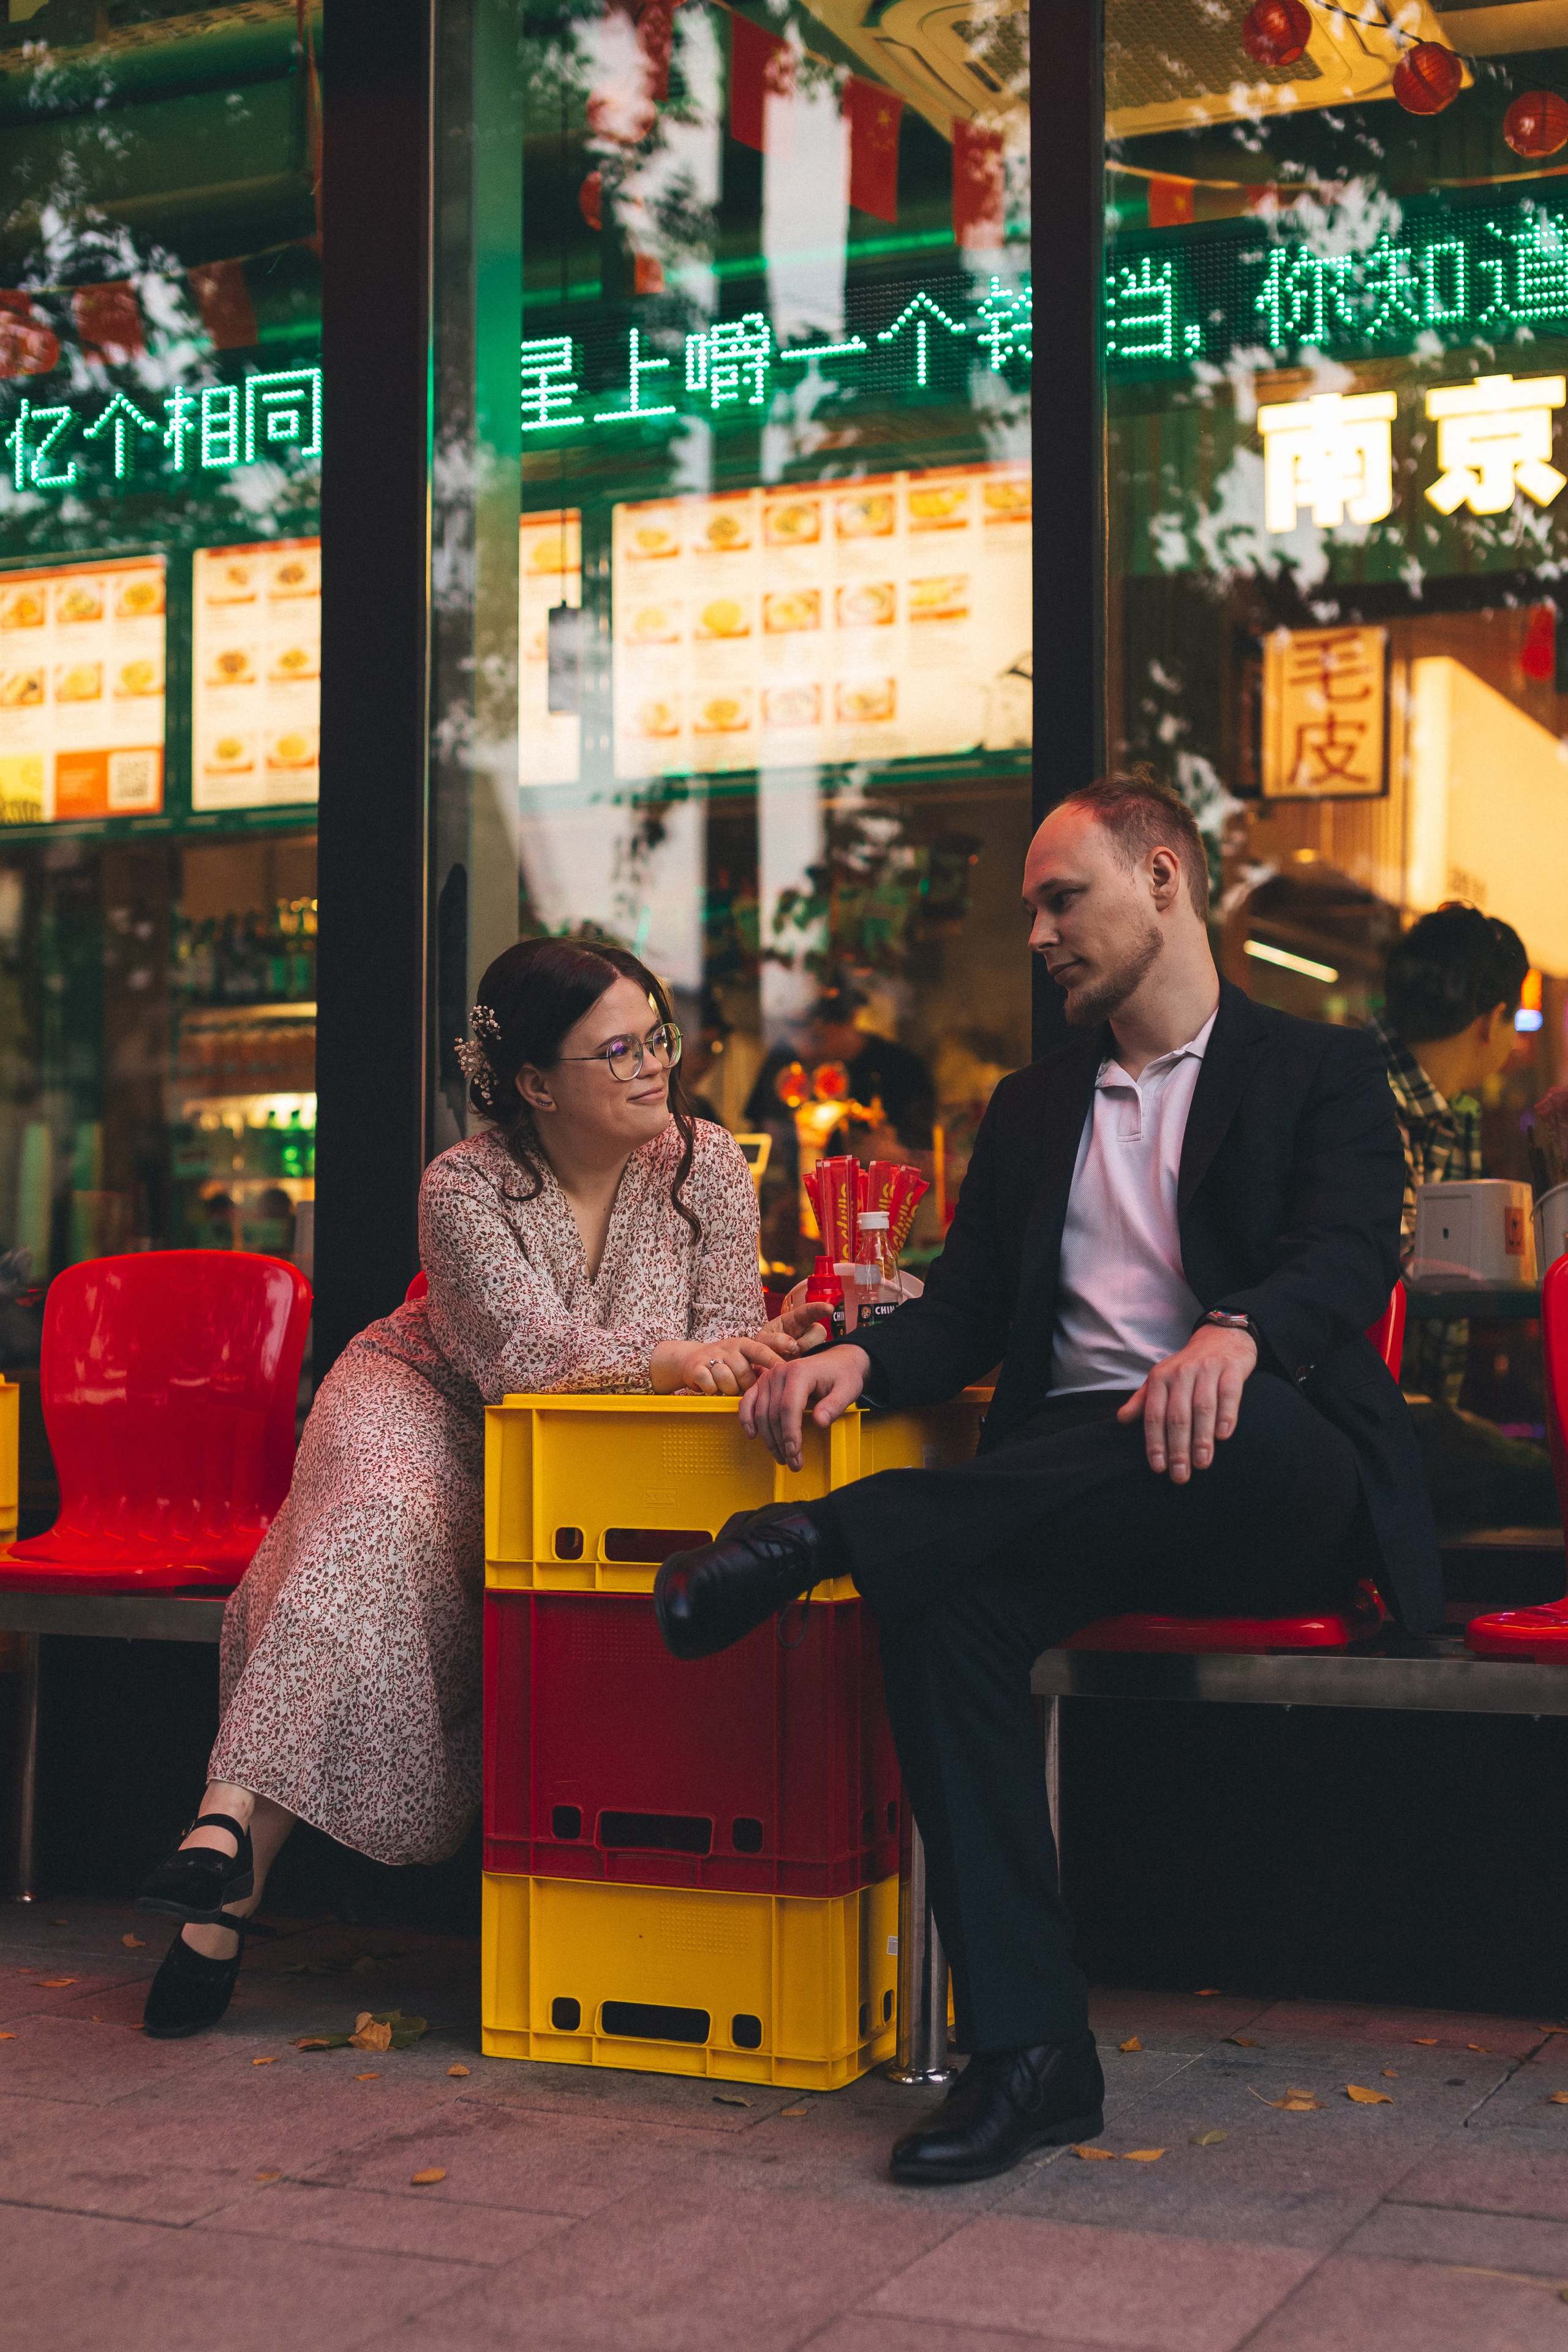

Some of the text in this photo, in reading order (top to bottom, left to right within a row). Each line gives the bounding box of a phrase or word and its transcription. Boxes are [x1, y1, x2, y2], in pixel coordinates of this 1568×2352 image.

[5, 368, 323, 492] 亿个相同
[1256, 372, 1568, 534] 南京
[875, 1305, 898, 1316] CHIN
